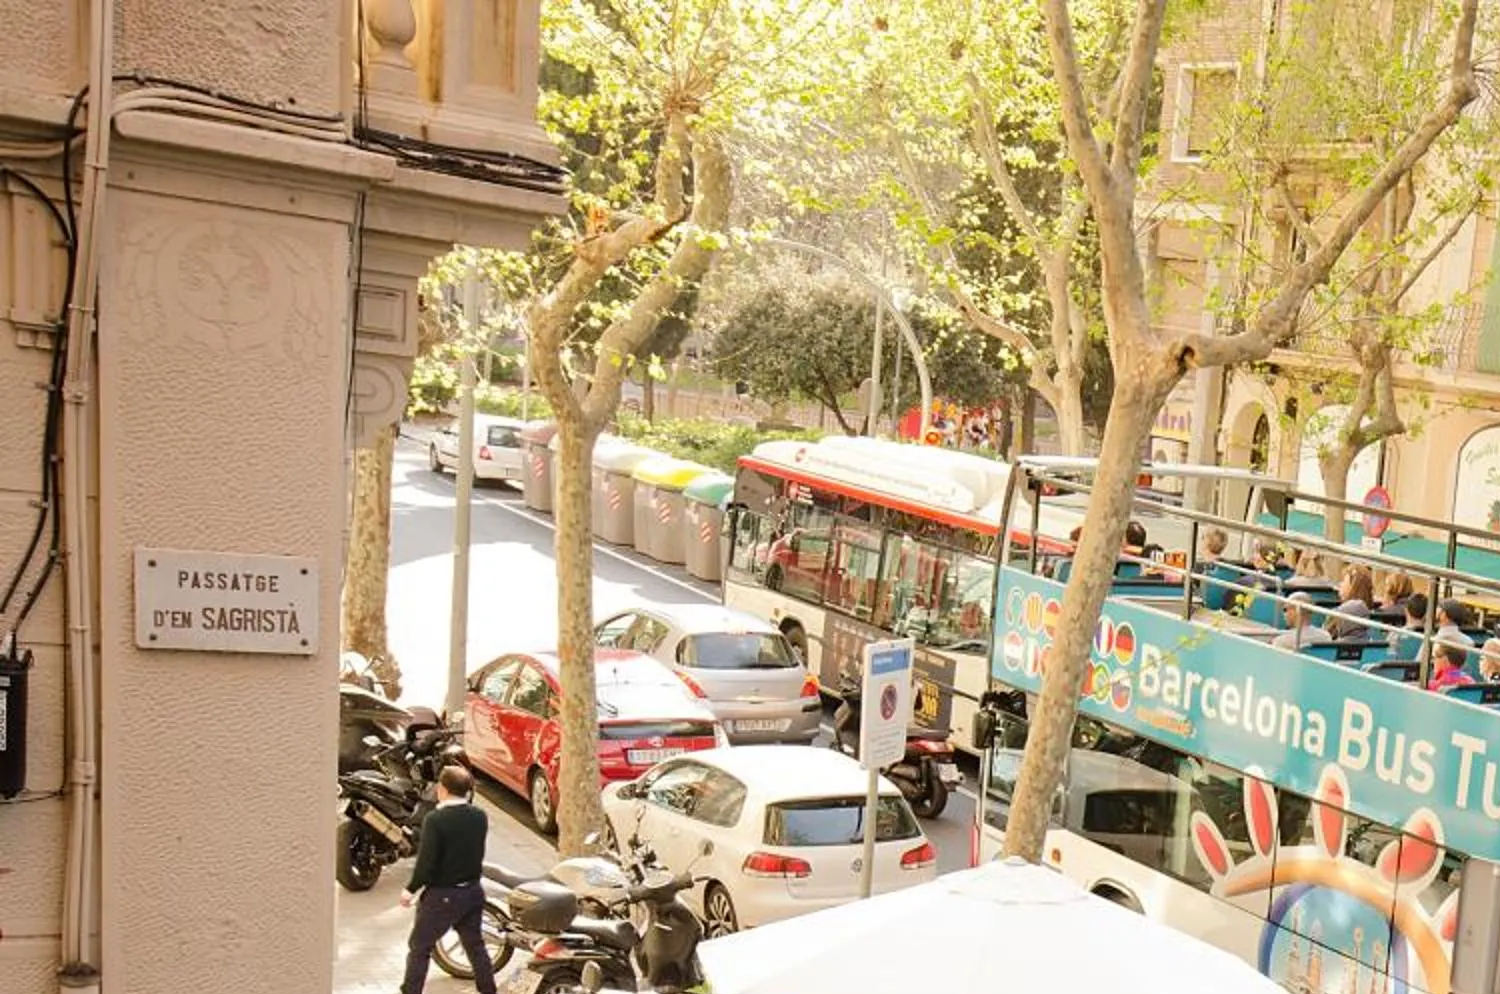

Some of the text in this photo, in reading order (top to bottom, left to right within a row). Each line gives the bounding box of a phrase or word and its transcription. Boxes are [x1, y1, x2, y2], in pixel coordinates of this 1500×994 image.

[178, 570, 280, 593] PASSATGE
[153, 602, 301, 634] D'EN SAGRISTÀ
[1139, 642, 1327, 757] Barcelona
[1338, 698, 1437, 795] Bus
